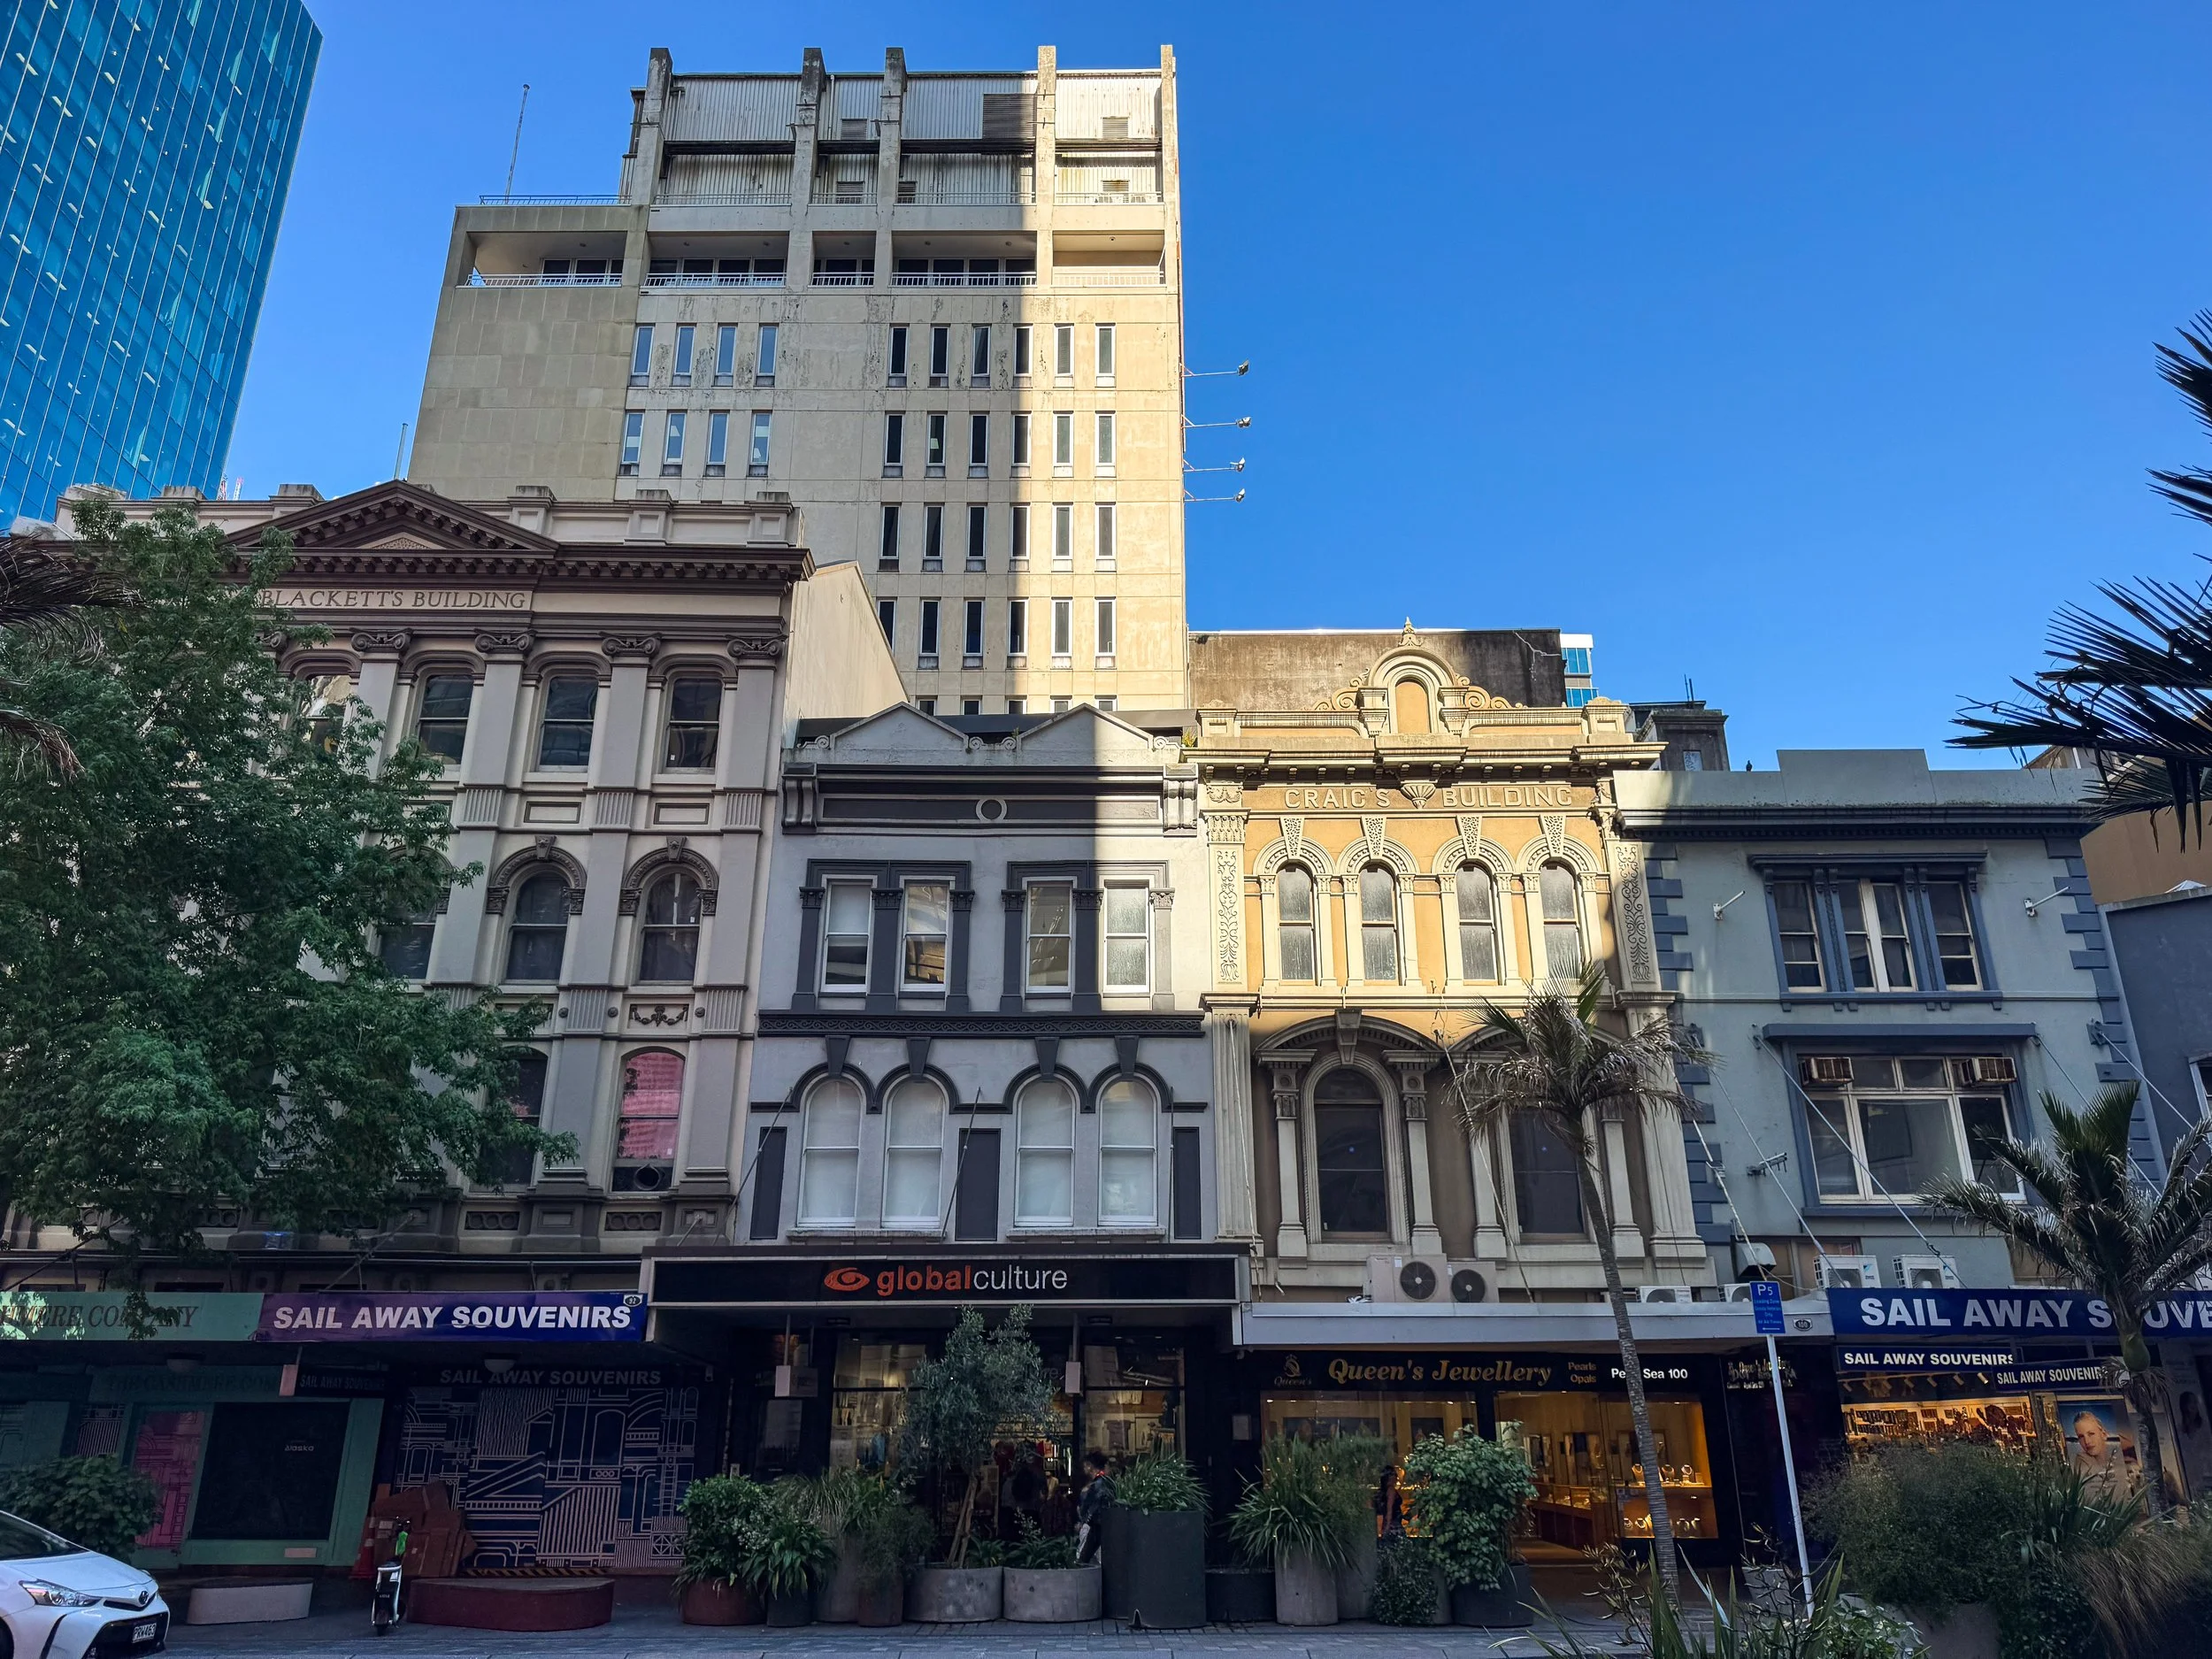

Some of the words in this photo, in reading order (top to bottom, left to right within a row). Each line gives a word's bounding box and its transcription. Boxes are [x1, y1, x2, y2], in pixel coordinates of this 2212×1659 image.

[261, 590, 403, 609] BLACKETT'S
[412, 592, 526, 609] BUILDING
[1285, 787, 1391, 809] CRAIG'S
[1442, 787, 1573, 808] BUILDING
[273, 1306, 342, 1330] SAIL
[351, 1306, 442, 1329] AWAY
[451, 1305, 631, 1330] SOUVENIRS
[1861, 1297, 1952, 1327] SAIL
[1962, 1299, 2073, 1328] AWAY
[2086, 1299, 2212, 1329] SUVE
[1568, 1362, 1597, 1371] Pearls
[1844, 1352, 1879, 1365] SAIL
[1882, 1353, 1925, 1366] AWAY
[440, 1369, 482, 1384] SAIL
[488, 1370, 546, 1384] AWAY
[549, 1370, 662, 1385] SOUVENIRS
[1328, 1358, 1424, 1386] Queen's
[1432, 1359, 1553, 1386] Jewellery
[1570, 1374, 1597, 1385] Opals
[1642, 1368, 1665, 1379] Sea
[1668, 1368, 1688, 1379] 100
[1996, 1371, 2018, 1385] SAIL
[2020, 1369, 2047, 1384] AWAY
[300, 1373, 319, 1388] SAIL
